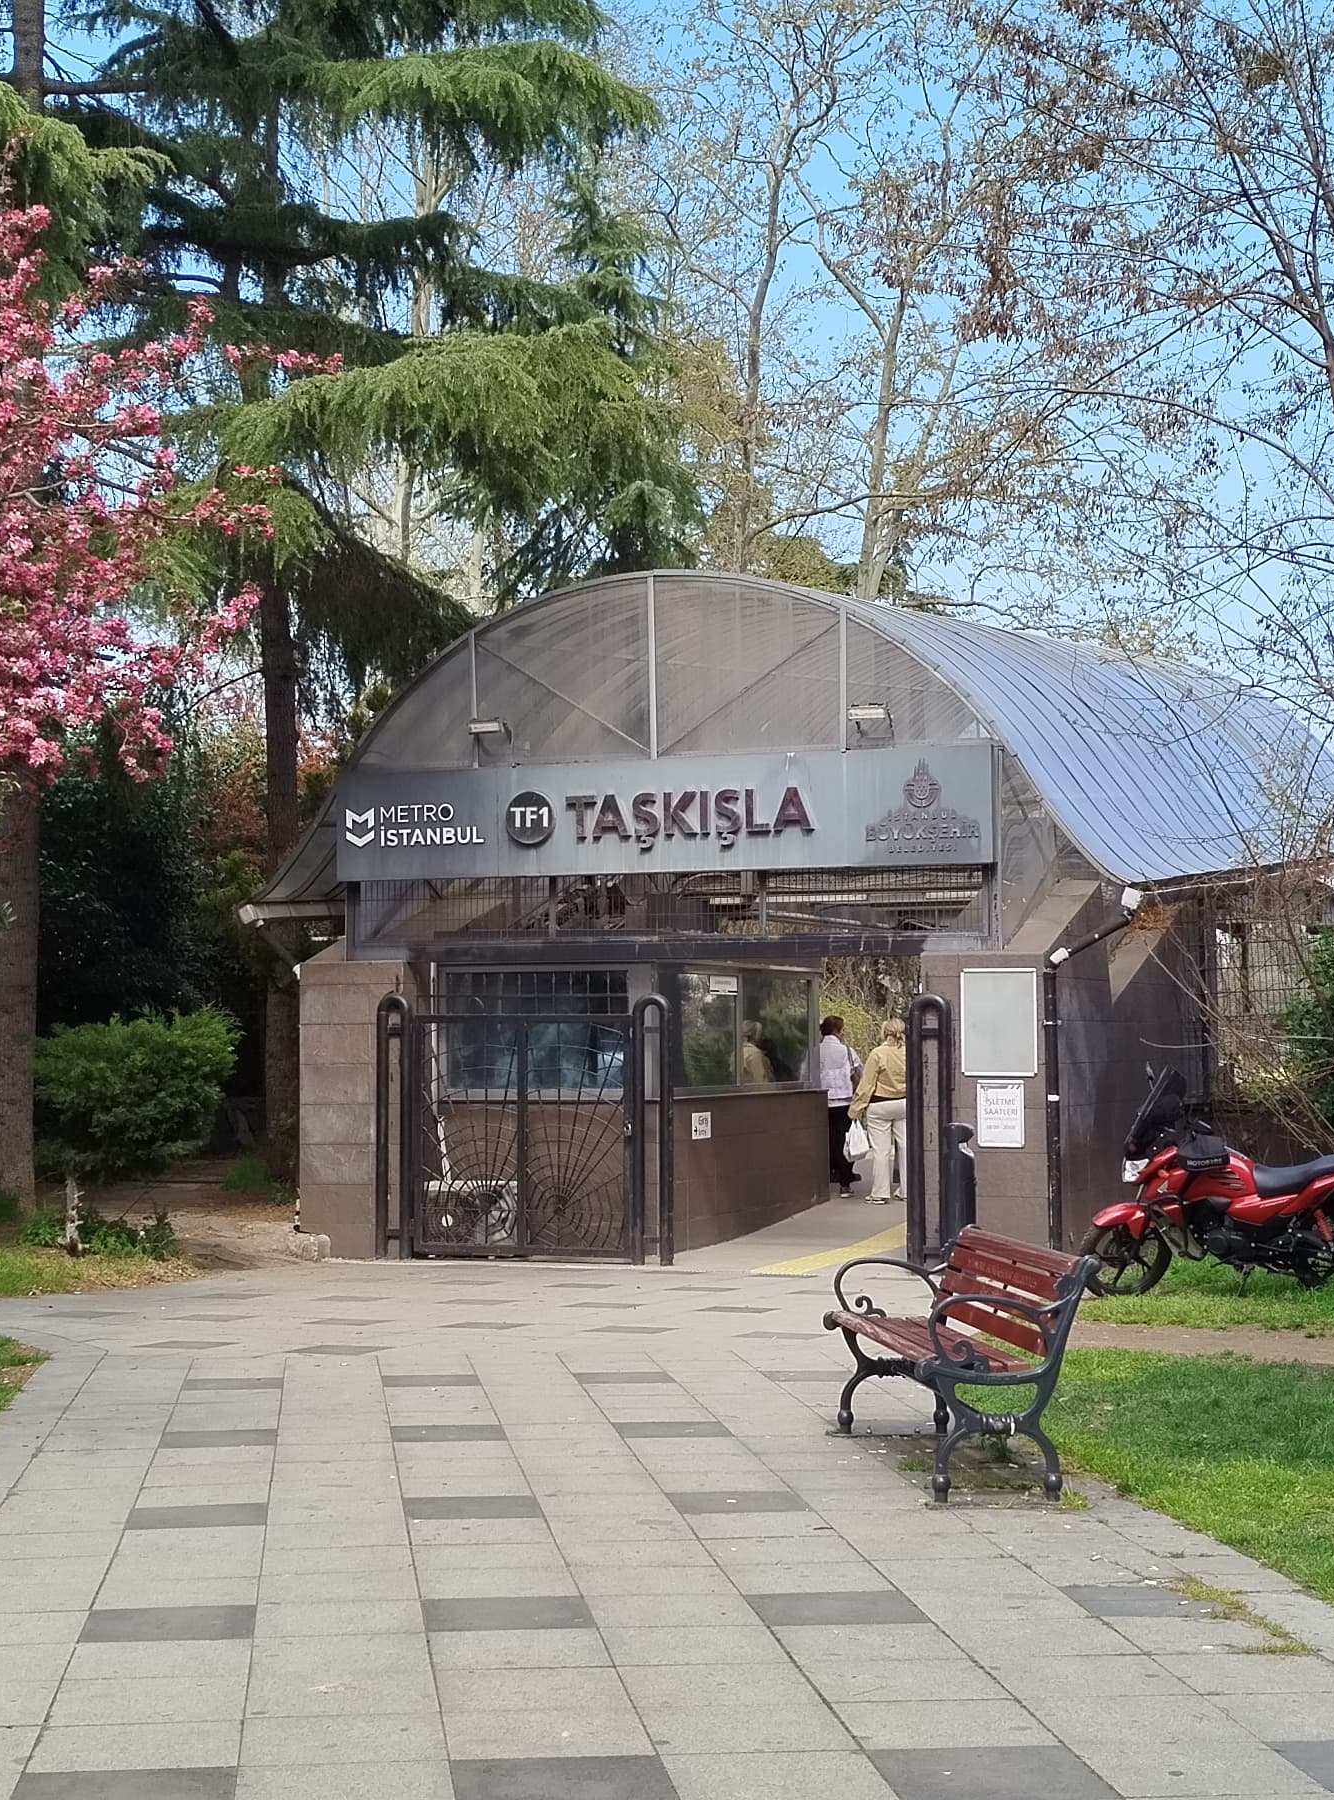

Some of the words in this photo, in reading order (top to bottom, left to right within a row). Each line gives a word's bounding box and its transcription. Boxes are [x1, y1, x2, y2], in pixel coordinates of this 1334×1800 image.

[379, 803, 454, 824] METRO
[510, 806, 549, 828] TF1
[565, 787, 815, 849] TAŞKIŞLA
[379, 826, 484, 848] İSTANBUL
